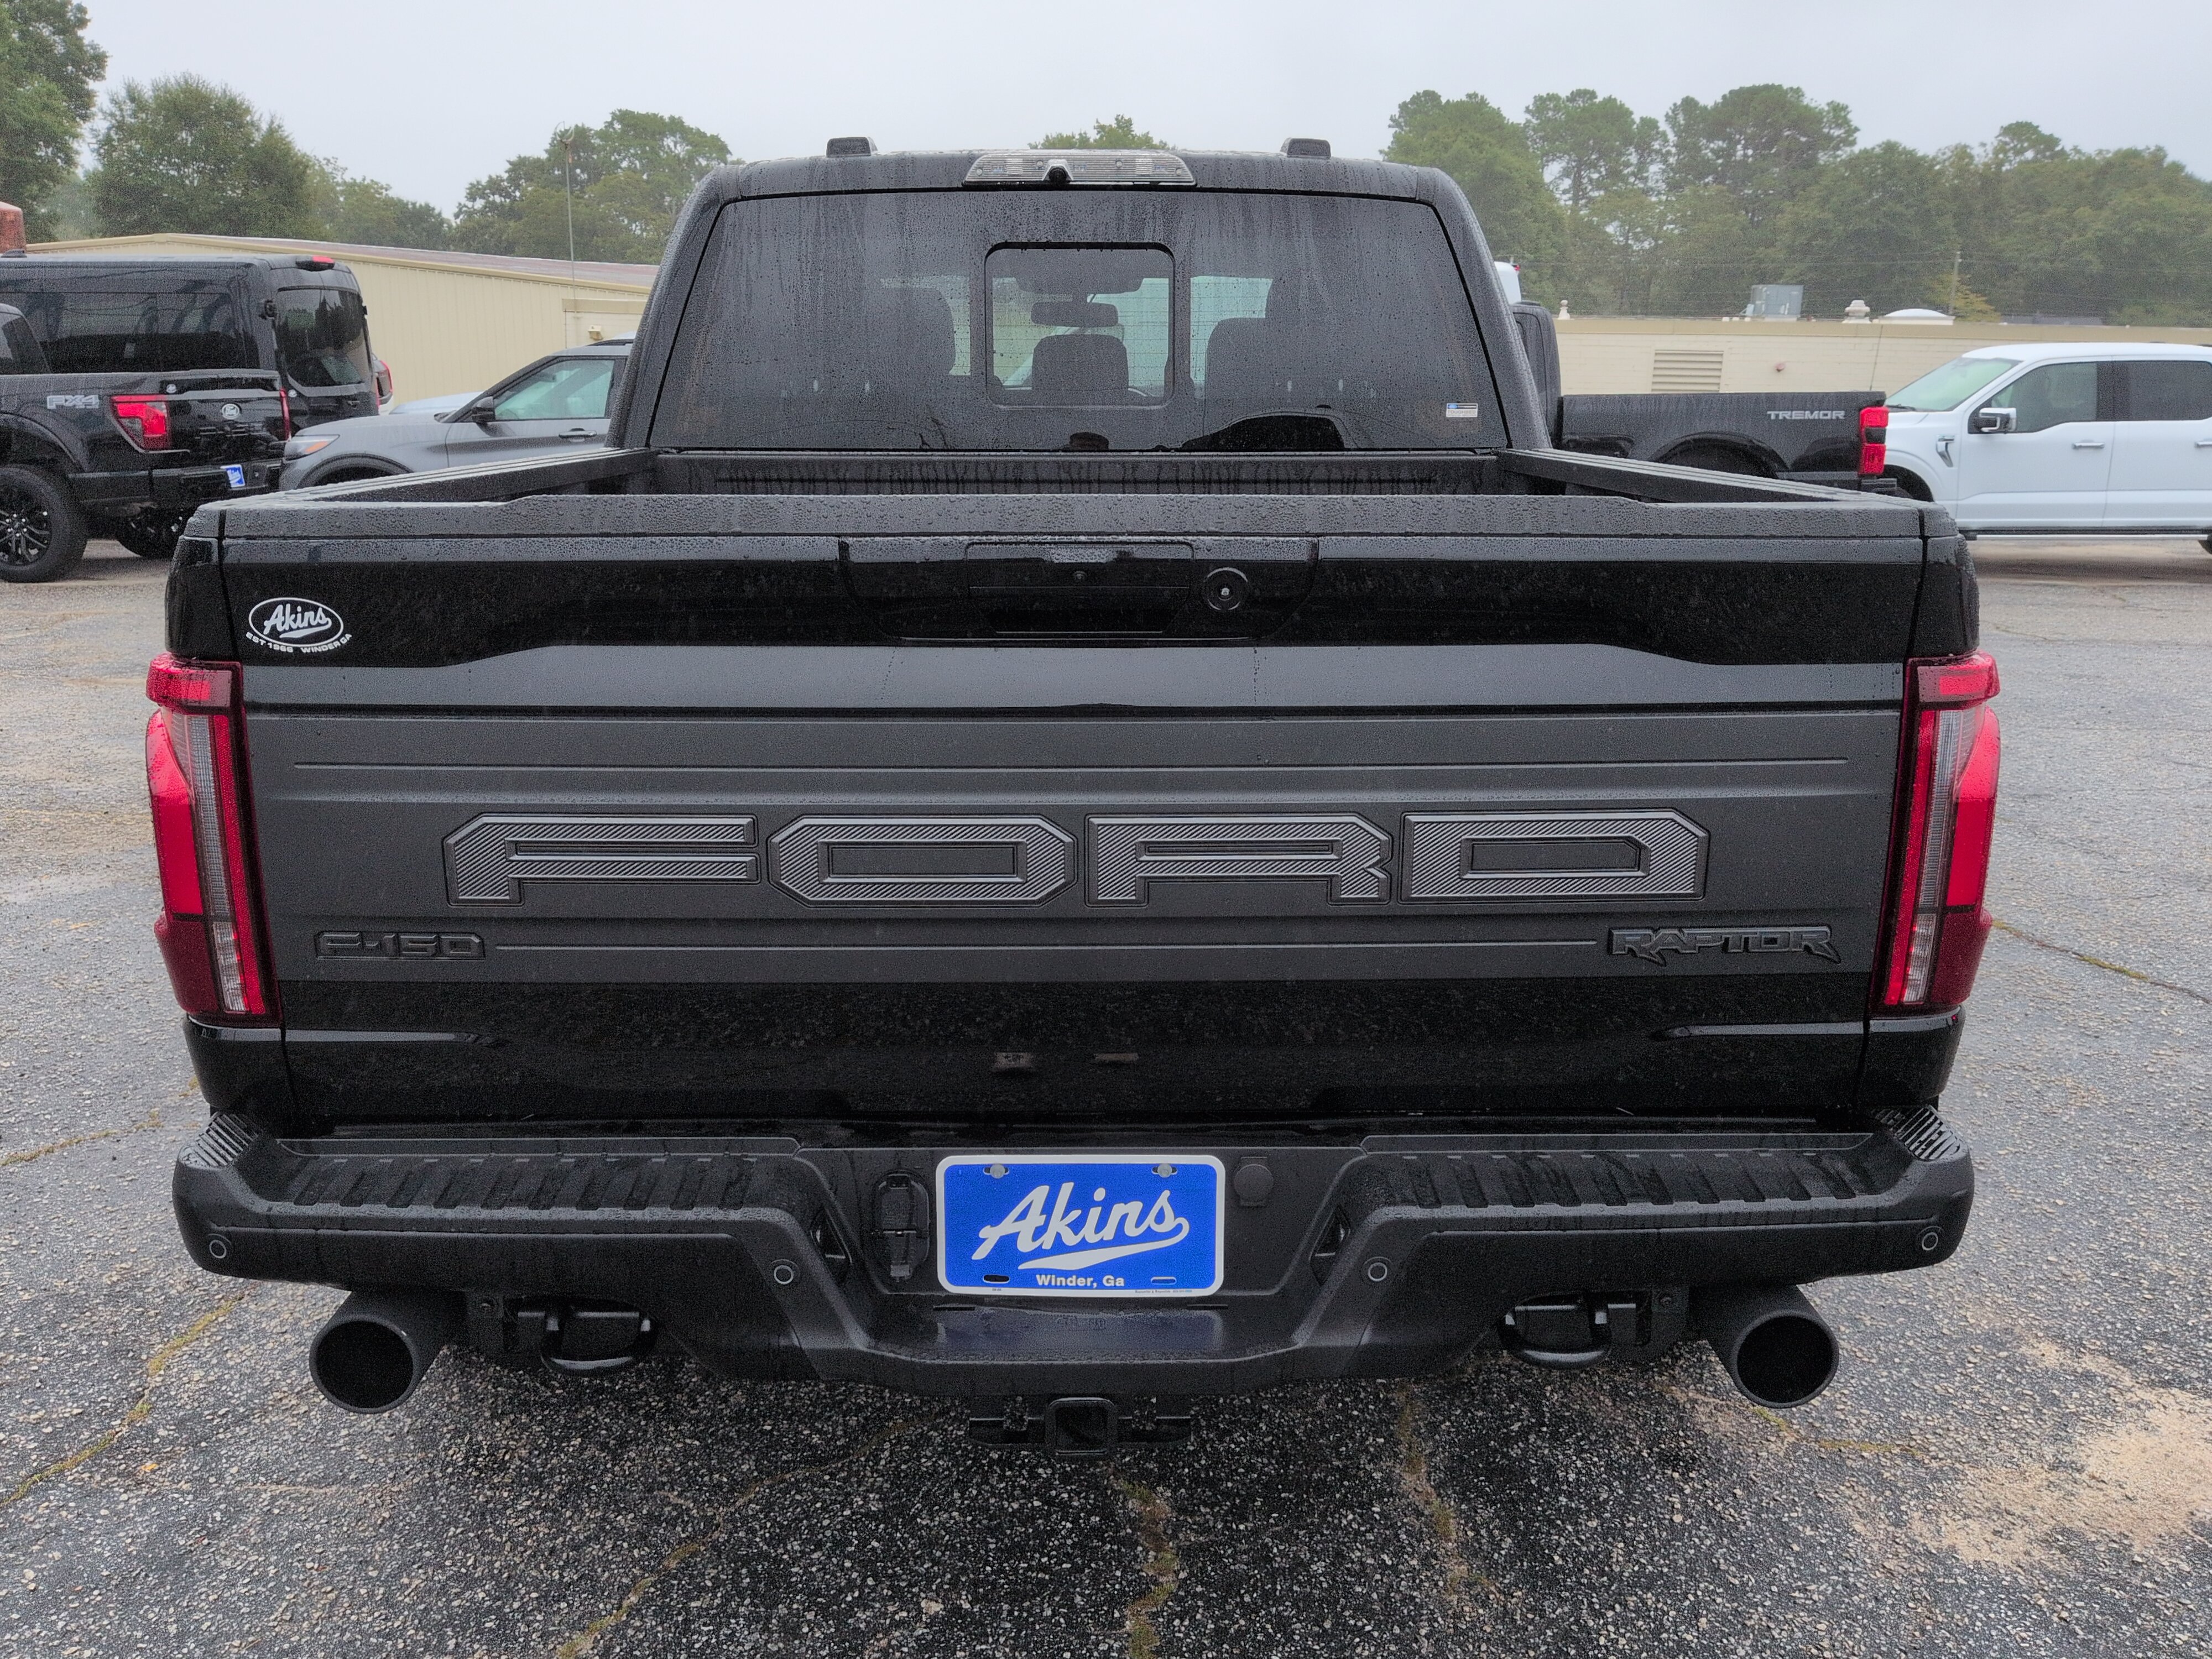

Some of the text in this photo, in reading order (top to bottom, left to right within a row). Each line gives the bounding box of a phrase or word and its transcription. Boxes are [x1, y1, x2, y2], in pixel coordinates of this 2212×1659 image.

[46, 394, 100, 409] FX4
[1767, 410, 1845, 420] TREMOR
[263, 603, 332, 638] Akins
[246, 632, 352, 653] EST 1966 WINDER GA
[444, 810, 1710, 906] FORD
[314, 931, 486, 961] F-150
[1609, 926, 1841, 966] RAPTOR
[971, 1181, 1190, 1270] Akins
[1036, 1274, 1124, 1288] Winder, Ga
